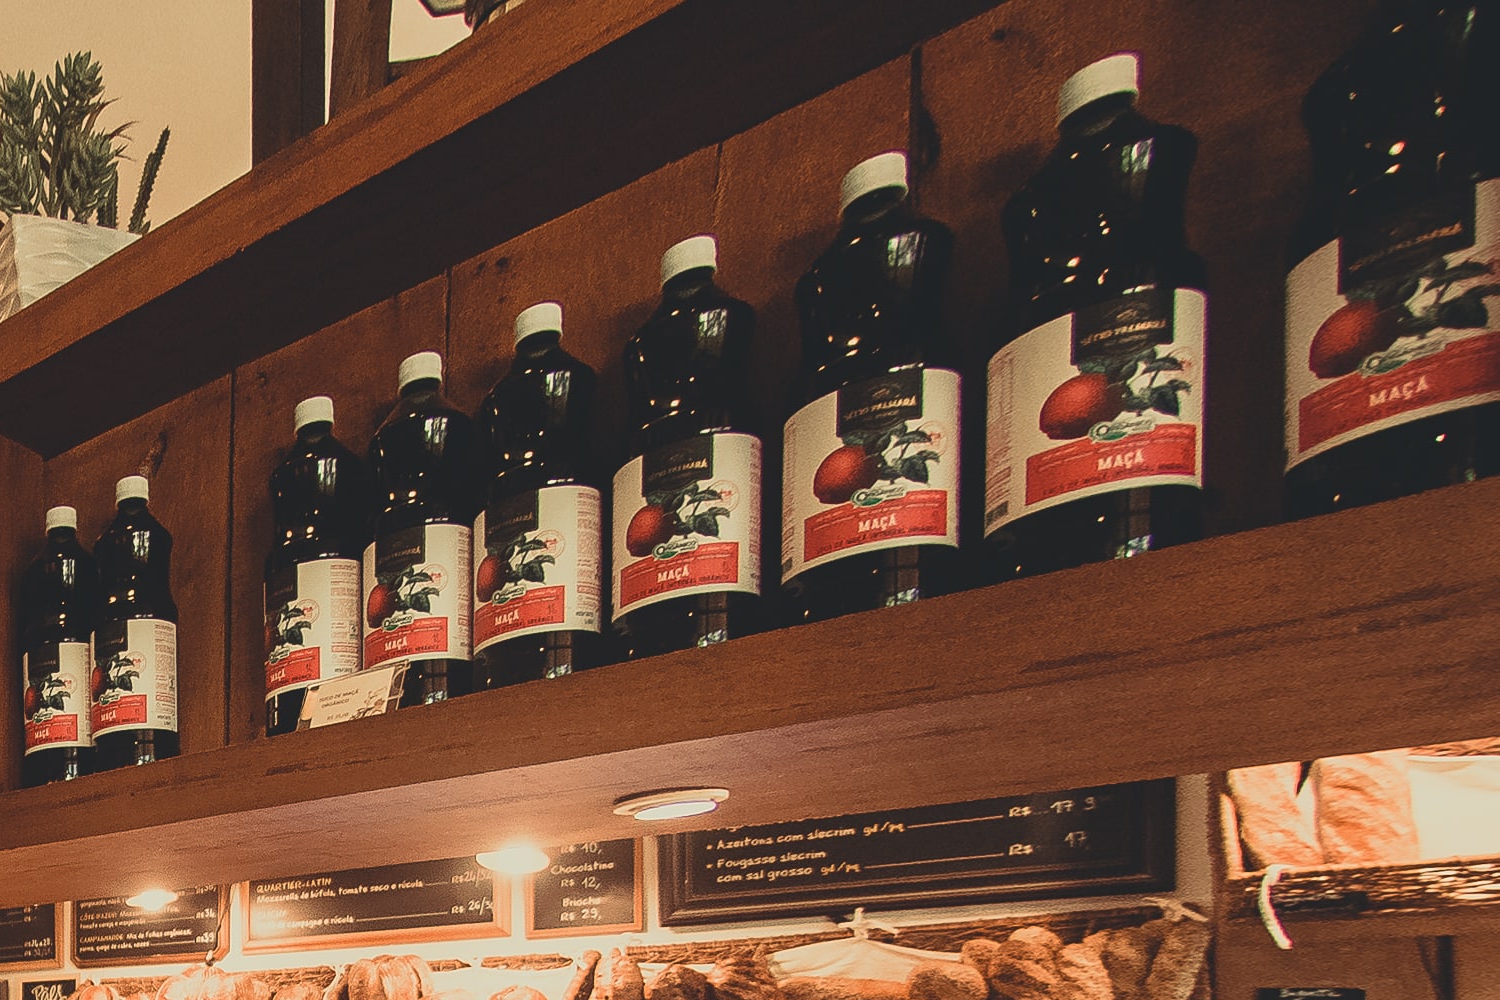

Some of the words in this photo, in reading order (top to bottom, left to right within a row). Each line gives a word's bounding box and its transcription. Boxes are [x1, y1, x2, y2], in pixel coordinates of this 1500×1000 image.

[717, 837, 774, 850] Azeitona
[777, 834, 803, 843] com
[807, 828, 855, 841] alecrim
[1009, 806, 1032, 817] R$
[561, 845, 575, 854] R$
[717, 855, 777, 868] Fougasse
[780, 850, 826, 862] alecrim
[717, 874, 743, 883] com
[746, 871, 764, 880] sal
[767, 868, 813, 881] grosso
[1009, 843, 1034, 855] R$
[256, 877, 333, 893] QUARTIER-LATIN
[561, 878, 575, 887] R$
[581, 876, 601, 890] 12,
[256, 892, 299, 904] Mozzarella
[300, 891, 309, 901] de
[338, 886, 368, 896] tomate
[370, 884, 389, 893] seco
[398, 879, 424, 889] rúcola
[562, 896, 602, 907] Brioche
[330, 915, 354, 924] rúcola
[451, 906, 464, 914] R$
[560, 911, 575, 921] R$
[581, 907, 601, 920] 29,
[145, 930, 163, 939] folhas
